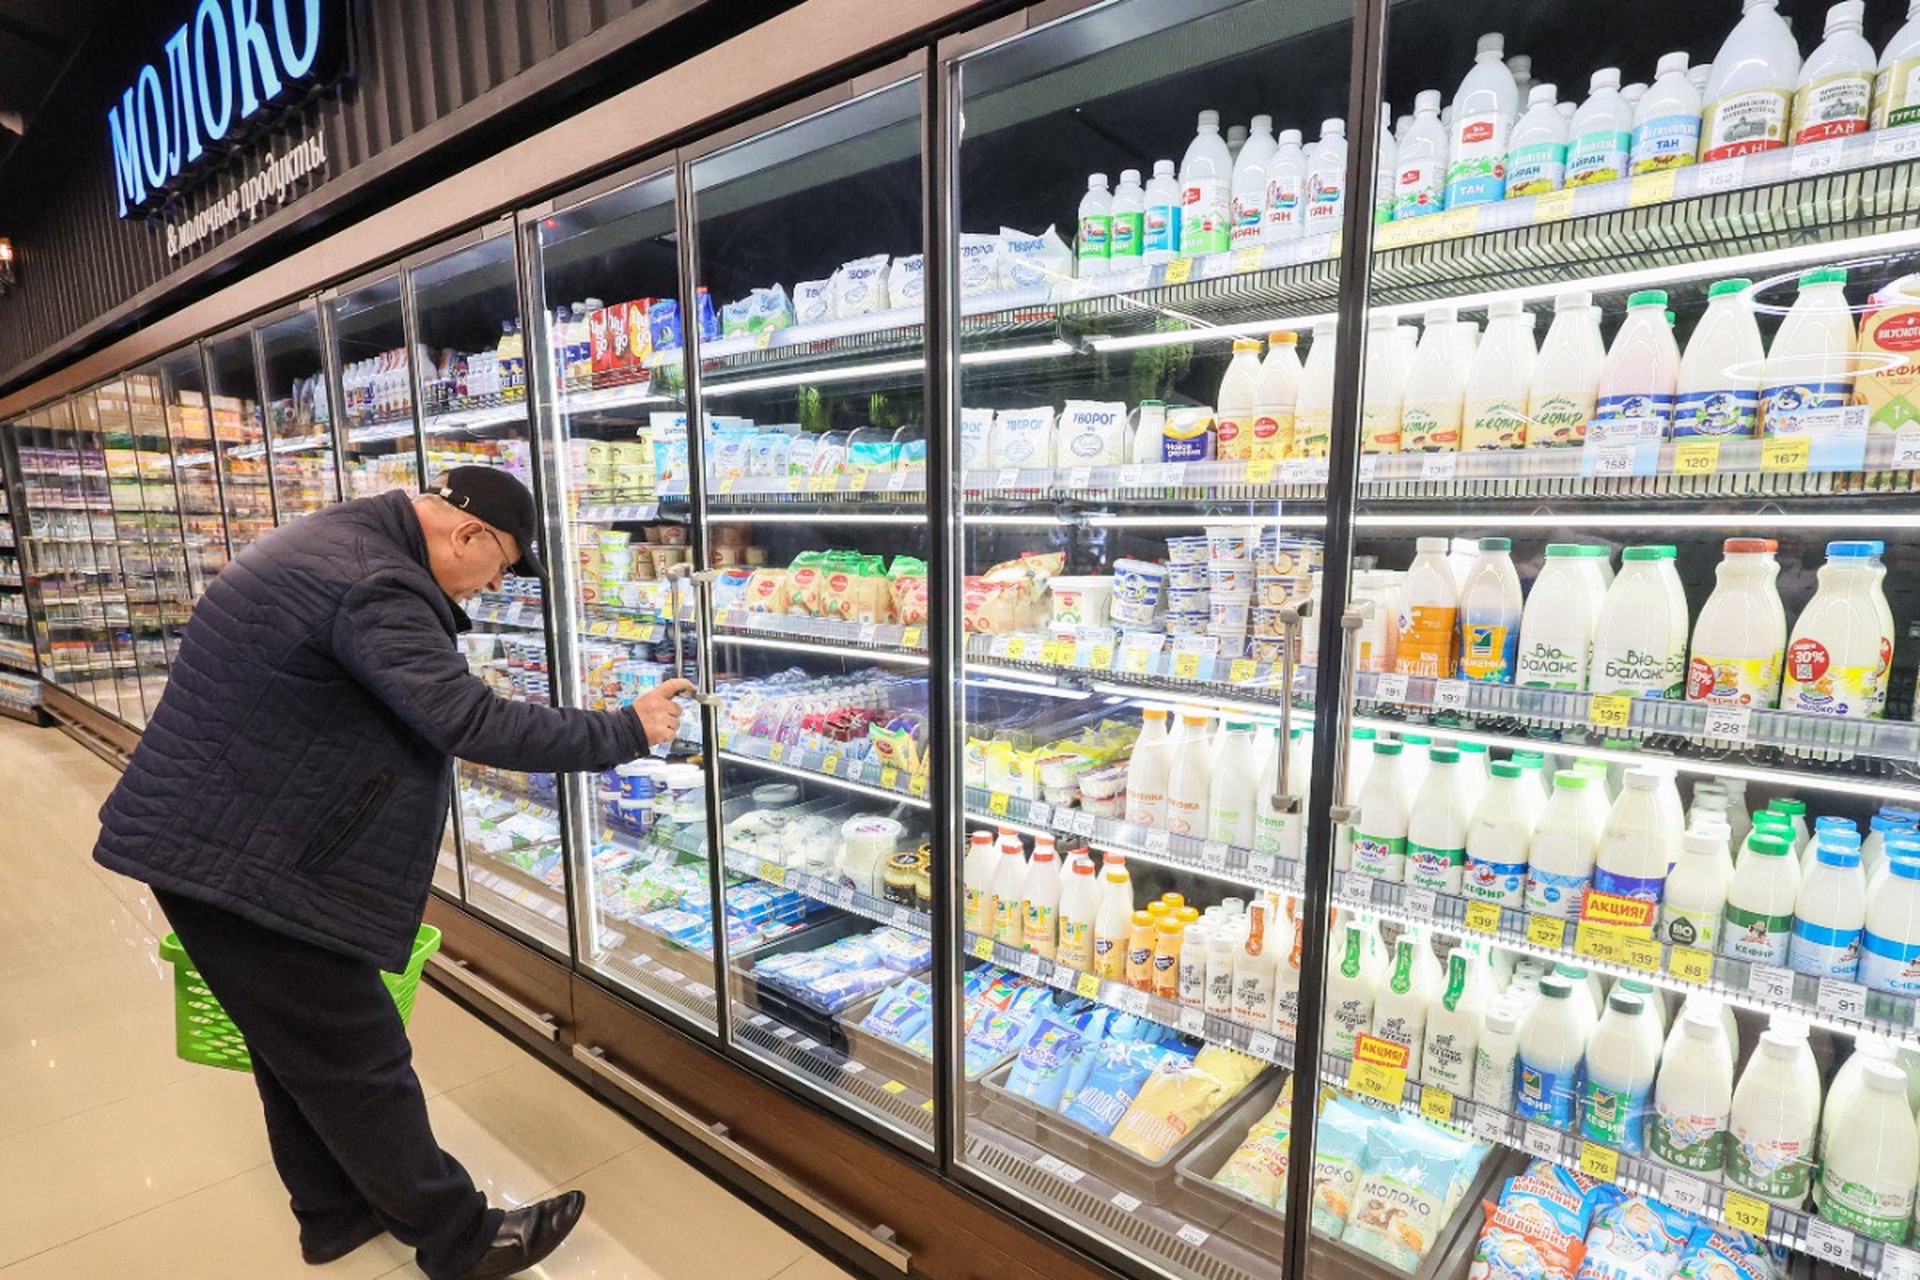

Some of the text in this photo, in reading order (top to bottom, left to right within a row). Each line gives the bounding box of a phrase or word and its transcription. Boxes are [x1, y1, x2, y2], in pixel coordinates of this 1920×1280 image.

[1823, 122, 1857, 137] ТАН
[1656, 138, 1681, 150] ТАН
[1725, 144, 1764, 159] ТАН
[240, 130, 328, 221] продукты
[1006, 419, 1046, 436] ТВОРОГ
[1073, 412, 1117, 430] ТВОРОГ
[1604, 459, 1627, 470] 158
[1684, 457, 1709, 469] 120
[1772, 453, 1799, 465] 167
[1535, 642, 1562, 660] Bio
[1627, 649, 1654, 667] Bio
[1522, 656, 1578, 674] баланс
[1600, 709, 1622, 721] 135
[1712, 722, 1740, 734] 228
[1413, 873, 1447, 889] Кефир
[1465, 882, 1506, 900] КЕФИР
[1589, 899, 1645, 920] АКЦИЯ!
[1535, 929, 1560, 942] 127
[1672, 923, 1693, 937] BIO
[1631, 952, 1653, 965] 139
[1734, 944, 1775, 959] КЕФИР
[1684, 963, 1702, 977] 88
[1767, 983, 1784, 996] 76
[1838, 999, 1856, 1011] 91
[1361, 1042, 1403, 1061] АКЦИЯ!
[1532, 1141, 1552, 1155] 182
[1660, 1144, 1707, 1169] КЕФИР
[1316, 1163, 1355, 1184] ЛОКО
[1737, 1172, 1791, 1196] КЕФИР
[1363, 1182, 1431, 1216] МОЛОКО
[1511, 1181, 1579, 1214] МОЛОЧНИК
[1734, 1211, 1758, 1226] 137
[1822, 1240, 1843, 1257] 99
